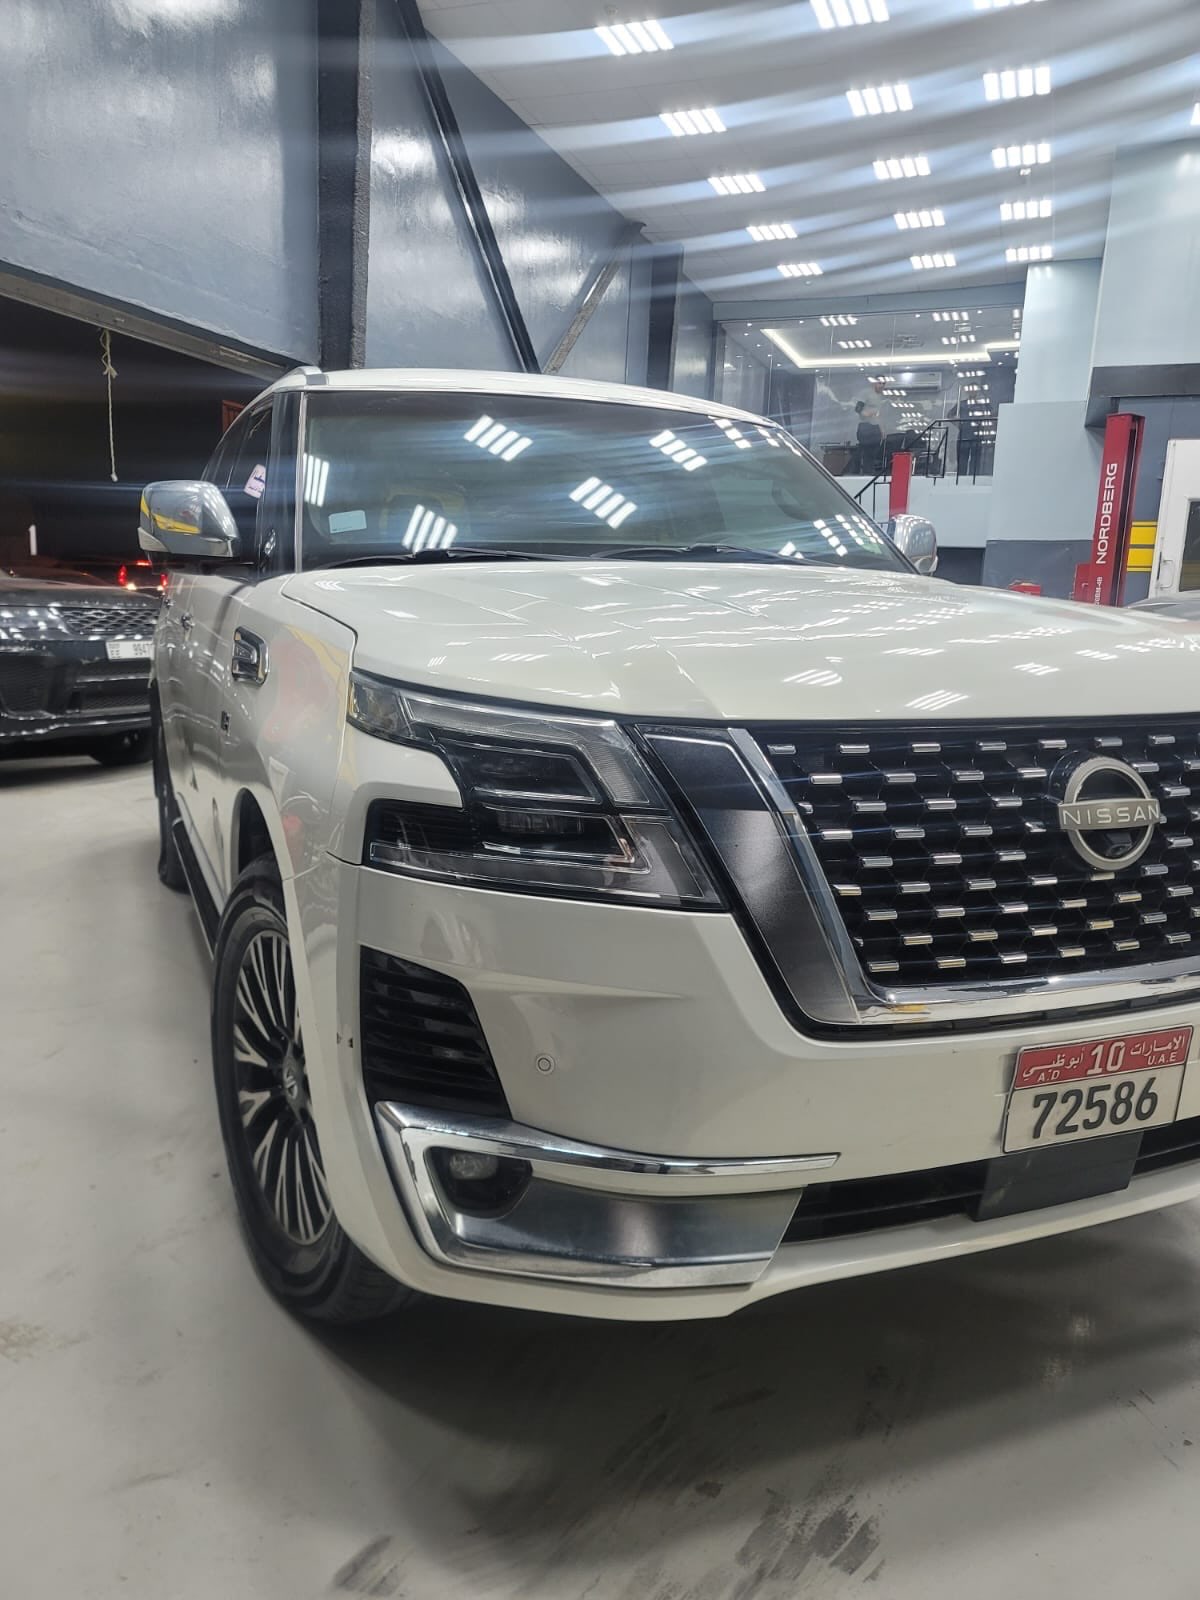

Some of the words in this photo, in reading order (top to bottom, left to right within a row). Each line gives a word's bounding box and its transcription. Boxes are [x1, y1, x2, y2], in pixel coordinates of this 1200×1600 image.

[1096, 463, 1118, 564] NORDBERG
[1062, 805, 1160, 825] NISSAN
[1086, 1041, 1126, 1076] 10
[1032, 1077, 1158, 1139] 72586
